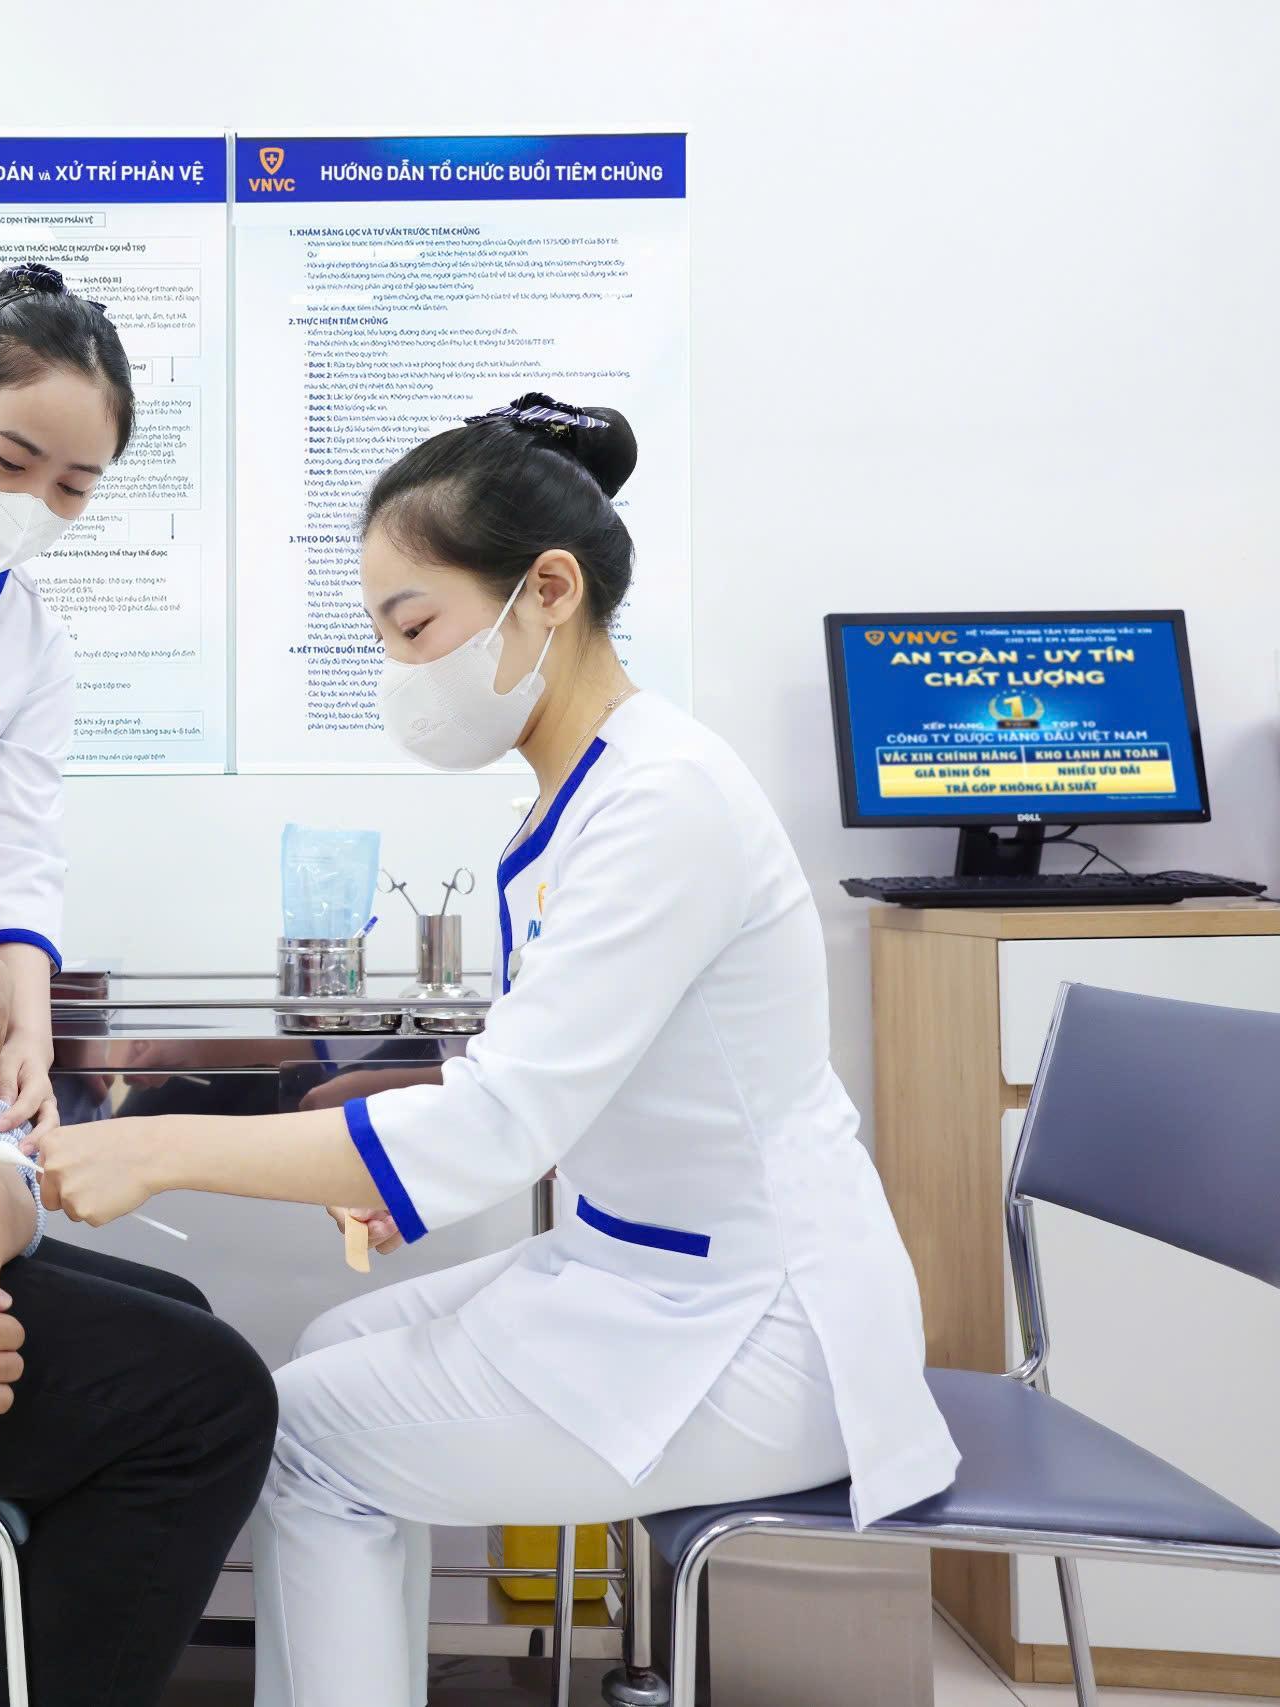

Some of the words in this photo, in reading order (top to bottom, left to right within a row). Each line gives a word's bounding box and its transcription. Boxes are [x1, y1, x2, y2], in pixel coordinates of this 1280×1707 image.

[38, 169, 51, 181] VÀ
[55, 159, 84, 181] XỬ
[86, 160, 118, 181] TRÍ
[121, 159, 174, 181] PHẢN
[179, 160, 205, 185] VỆ
[321, 161, 383, 181] HƯỚNG
[387, 159, 424, 181] DẪN
[429, 159, 452, 181] TỔ
[456, 161, 505, 181] CHỨC
[509, 159, 550, 181] BUỔI
[555, 161, 597, 181] TIÊM
[601, 161, 664, 181] CHỦNG
[248, 178, 296, 192] VNVC
[888, 631, 958, 645] VNVC
[891, 651, 932, 665] AN
[937, 646, 1018, 665] TOÀN
[1044, 649, 1082, 663] UY
[1087, 645, 1135, 663] TÍN
[924, 667, 1000, 687] CHẤT
[1007, 668, 1105, 688] LƯỢNG
[1003, 695, 1024, 719] 1
[886, 732, 928, 744] CÔNG
[931, 733, 950, 743] TY
[1114, 730, 1148, 740] NAM
[910, 752, 933, 762] XIN
[936, 751, 978, 762] CHÍNH
[1035, 751, 1062, 760] KHO
[1103, 749, 1121, 759] AN
[1124, 747, 1159, 759] TOÀN
[1017, 813, 1041, 822] DELL
